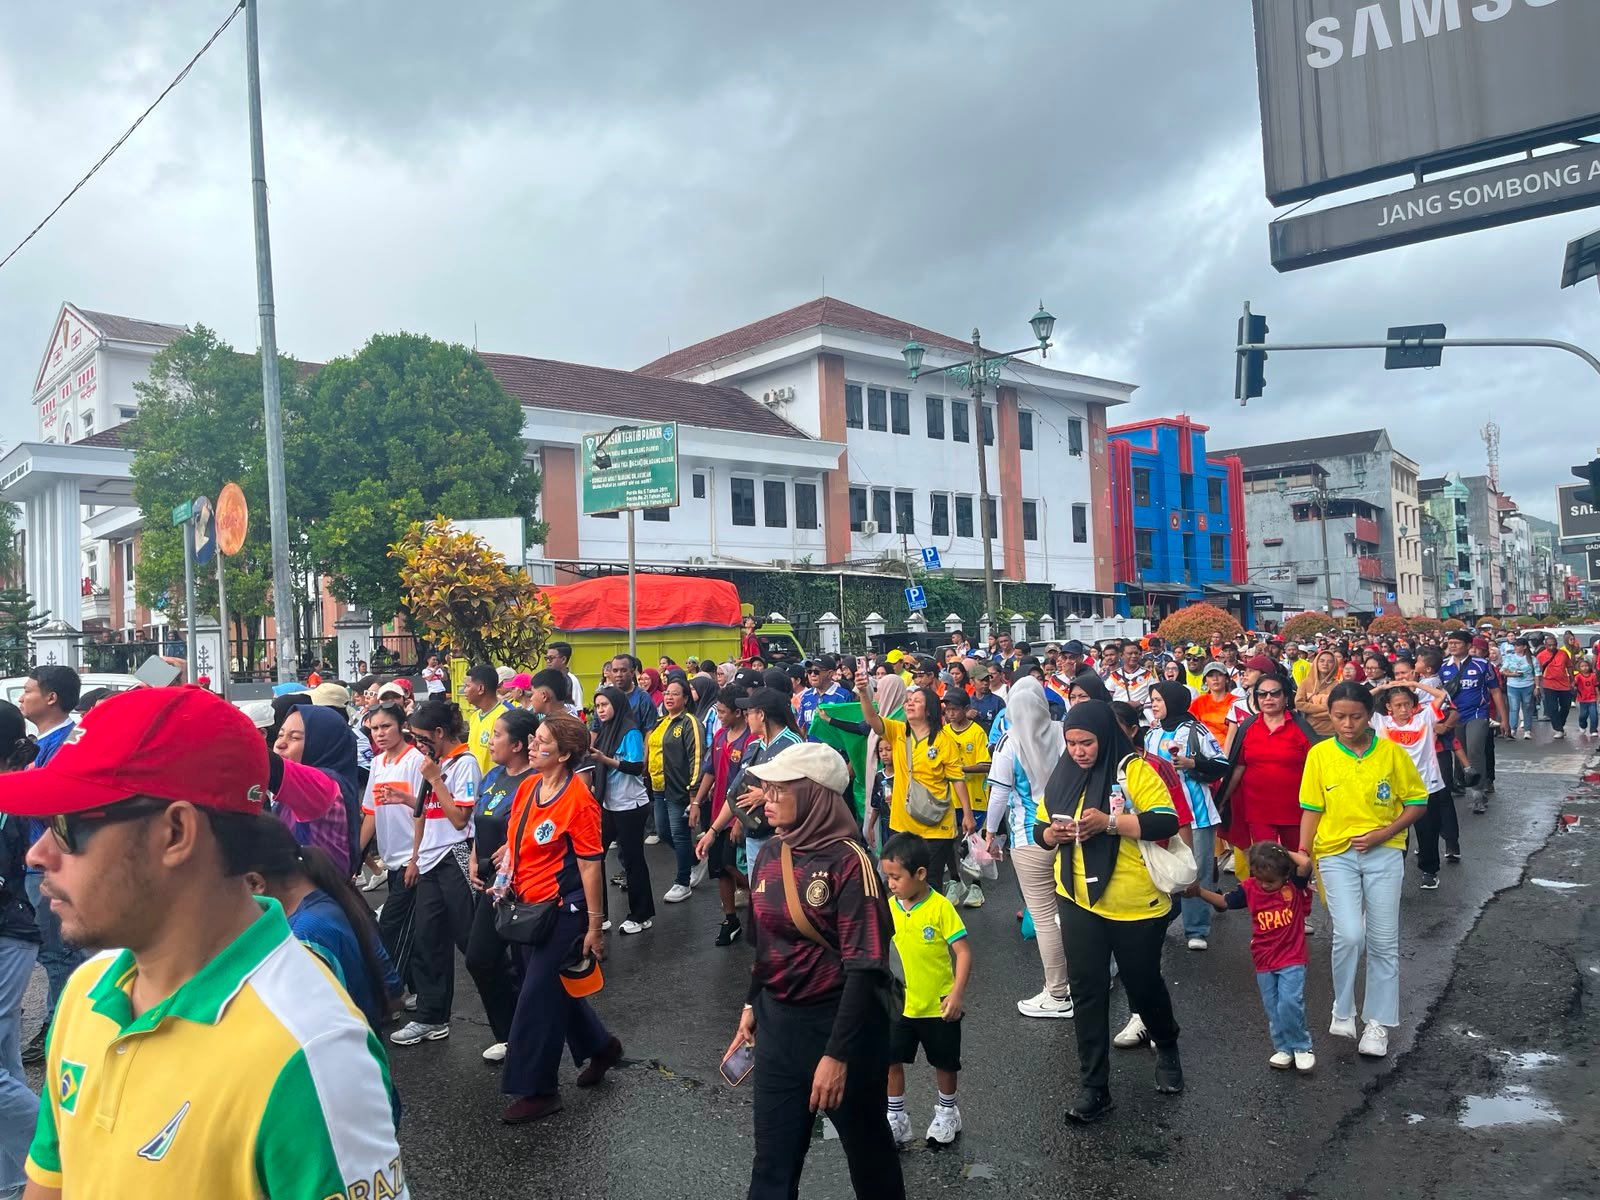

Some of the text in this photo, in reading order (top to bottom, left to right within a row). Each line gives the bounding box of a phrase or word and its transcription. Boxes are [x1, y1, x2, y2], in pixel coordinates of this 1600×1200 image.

[1304, 0, 1557, 69] SAM
[1377, 194, 1442, 227] JANG
[1449, 164, 1581, 210] SOMBONG
[925, 548, 934, 561] P
[910, 588, 919, 602] P
